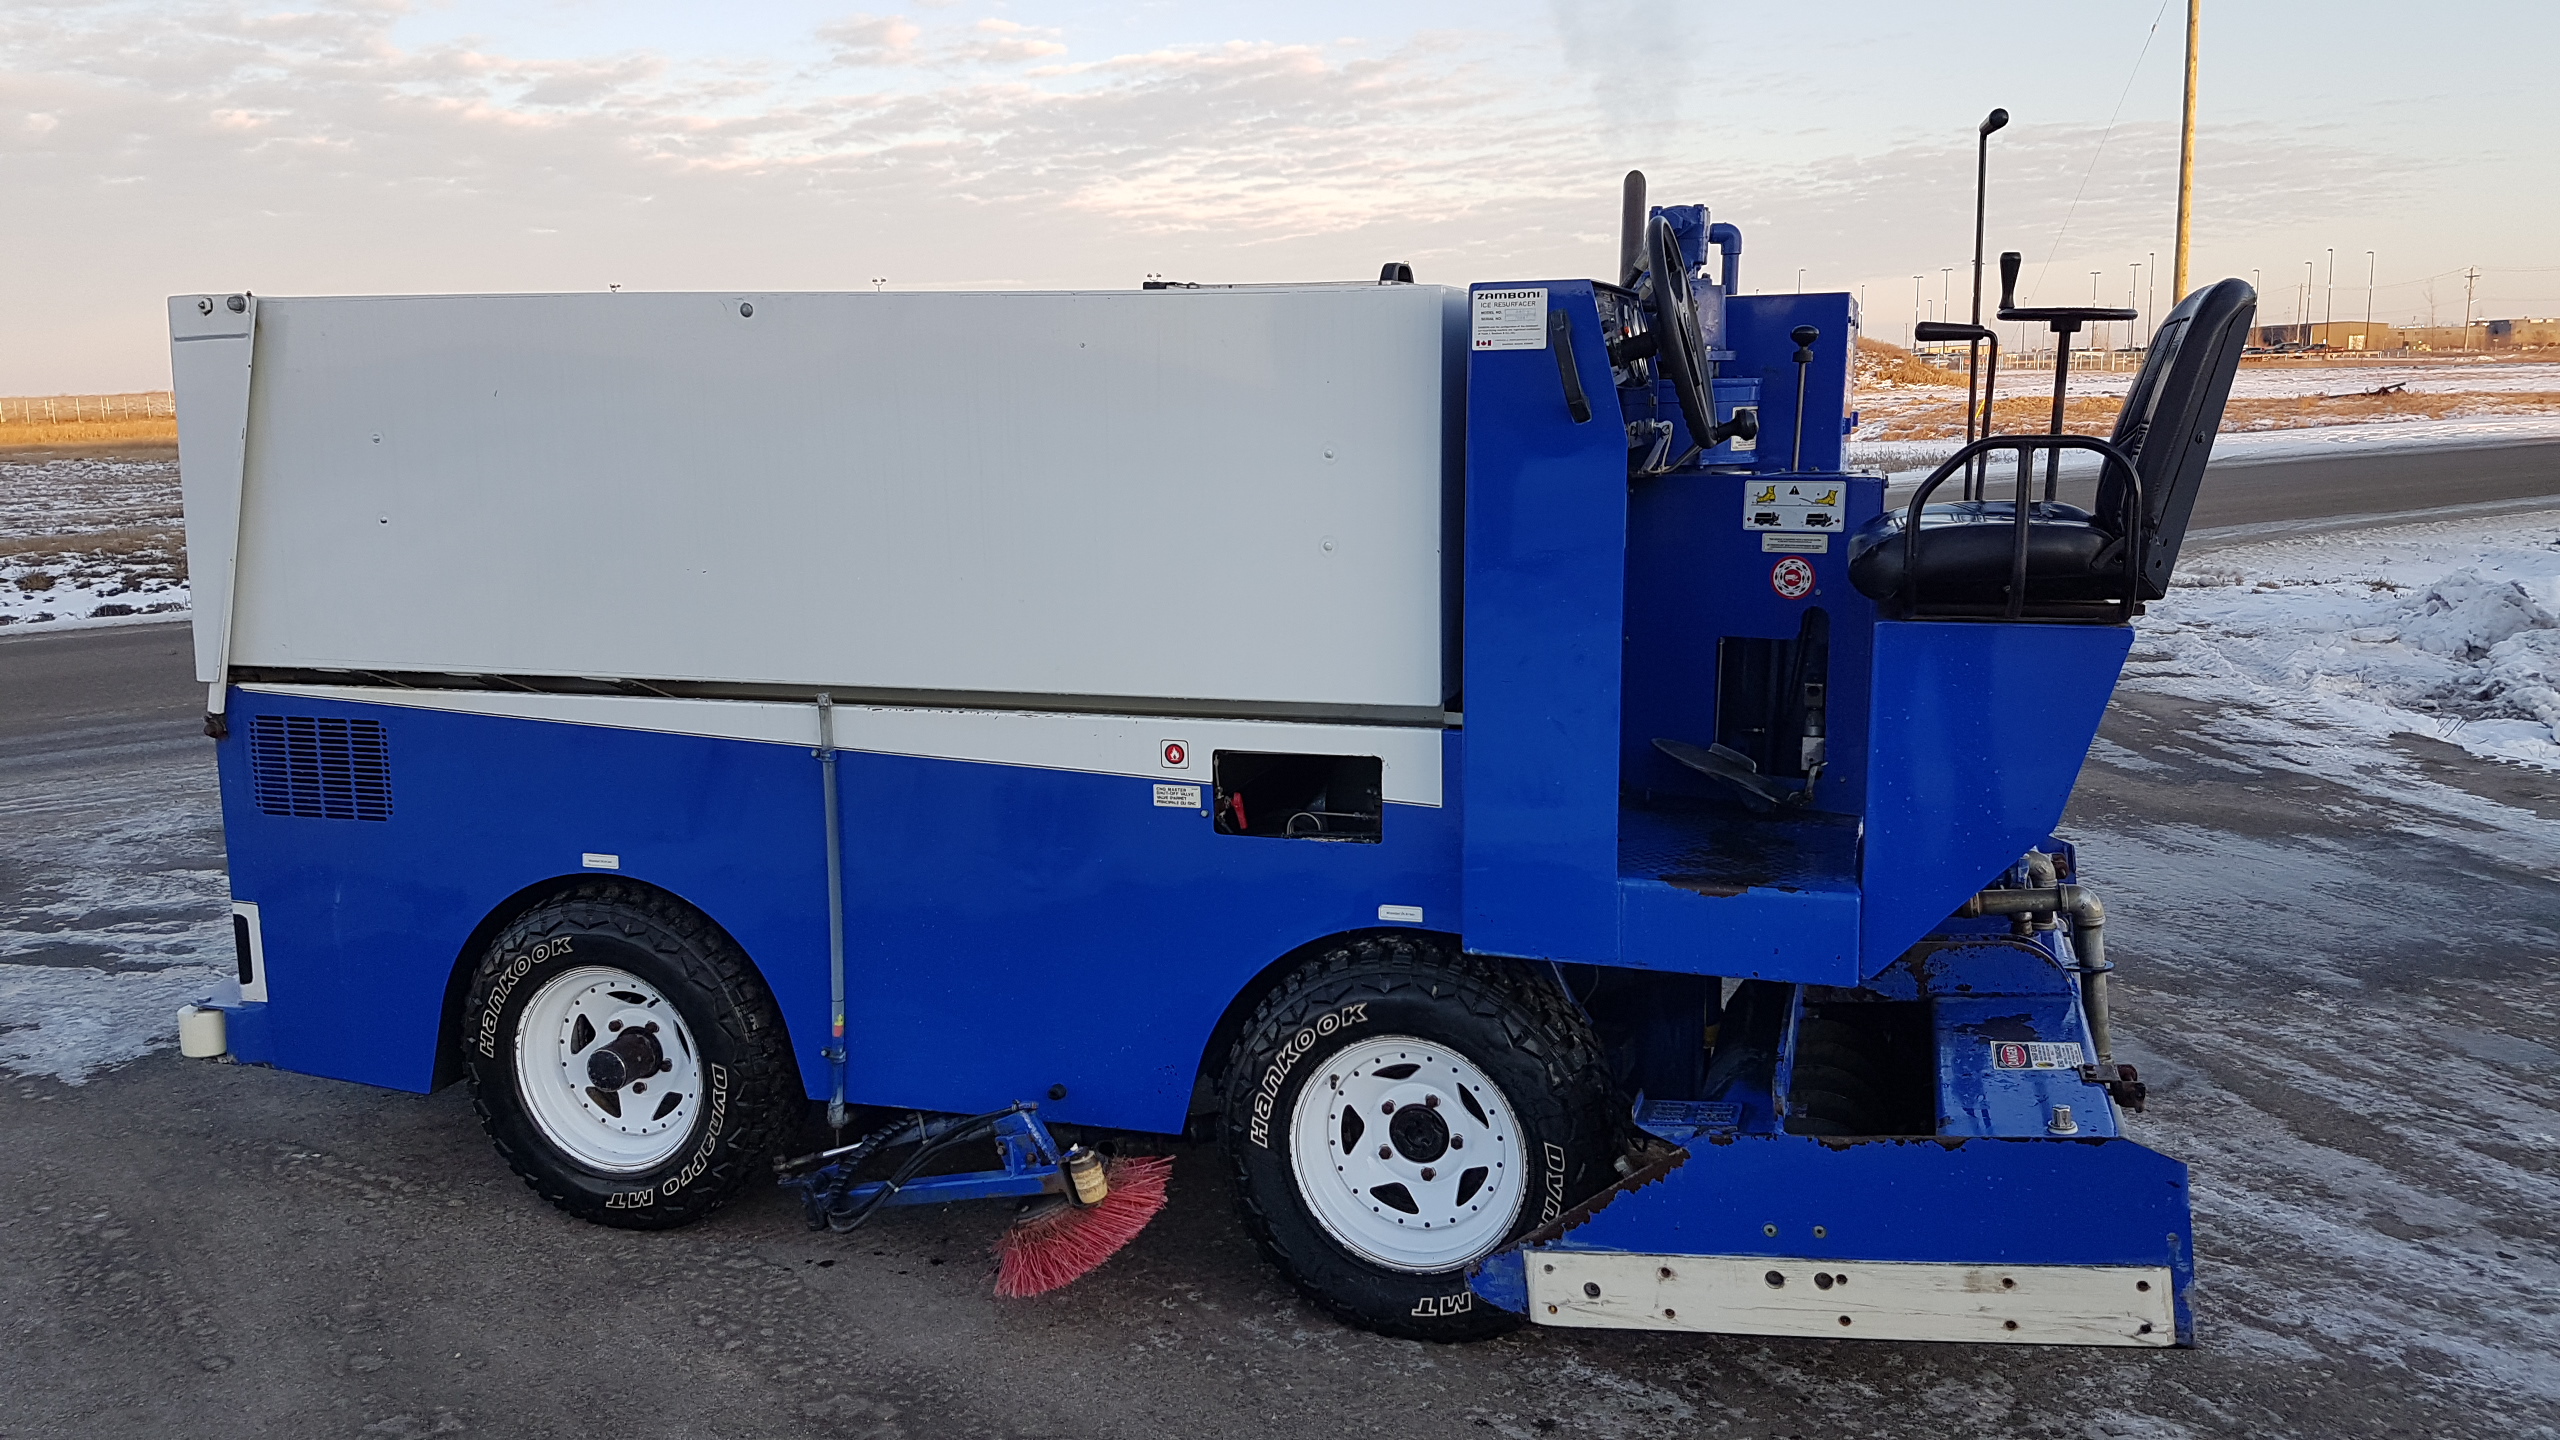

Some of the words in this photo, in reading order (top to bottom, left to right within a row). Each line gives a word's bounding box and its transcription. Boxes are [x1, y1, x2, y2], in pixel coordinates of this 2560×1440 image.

[1477, 291, 1540, 300] ZAMBONI
[1493, 300, 1536, 308] RESURFACER
[2006, 1046, 2020, 1066] DANGER
[605, 1188, 654, 1209] MT
[1411, 1290, 1472, 1317] MT
